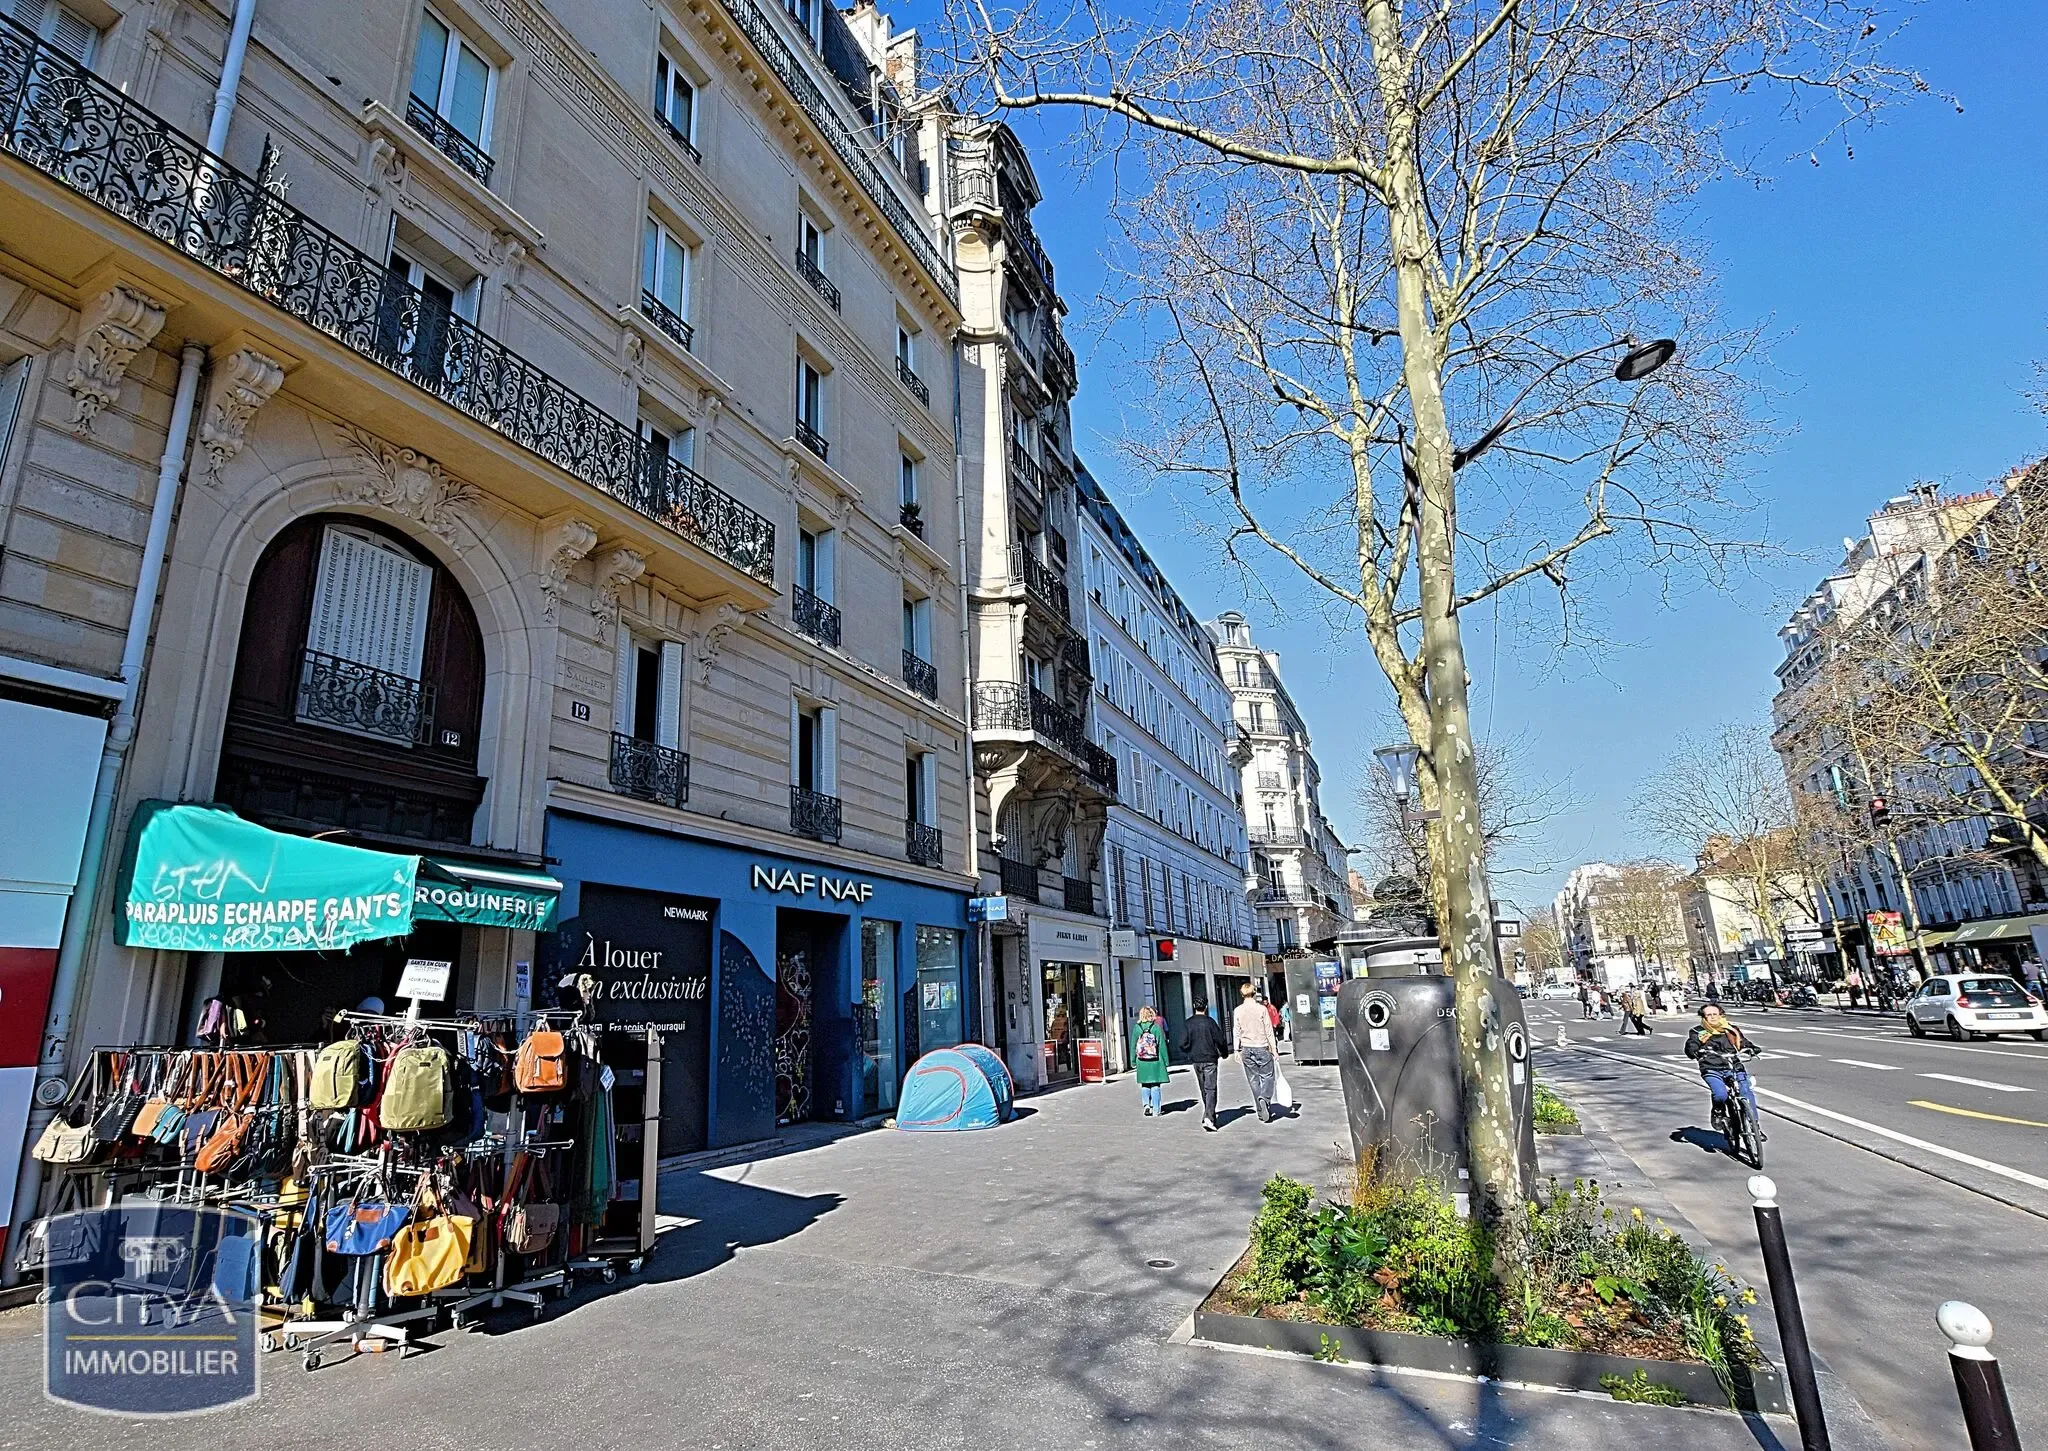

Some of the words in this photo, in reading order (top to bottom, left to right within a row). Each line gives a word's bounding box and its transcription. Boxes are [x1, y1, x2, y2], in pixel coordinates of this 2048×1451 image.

[575, 703, 587, 719] 12
[445, 732, 458, 745] 12
[754, 864, 816, 894] NAF
[821, 876, 873, 902] NAF
[126, 901, 219, 925] PARAPLUIS
[223, 898, 317, 925] ECHARPE
[323, 892, 402, 921] GANTS
[664, 906, 708, 921] NEWMARK
[1505, 925, 1515, 933] 12
[578, 931, 597, 967] À
[603, 941, 663, 969] louer
[610, 973, 707, 999] exclusivité
[645, 1020, 686, 1033] Chouraqui
